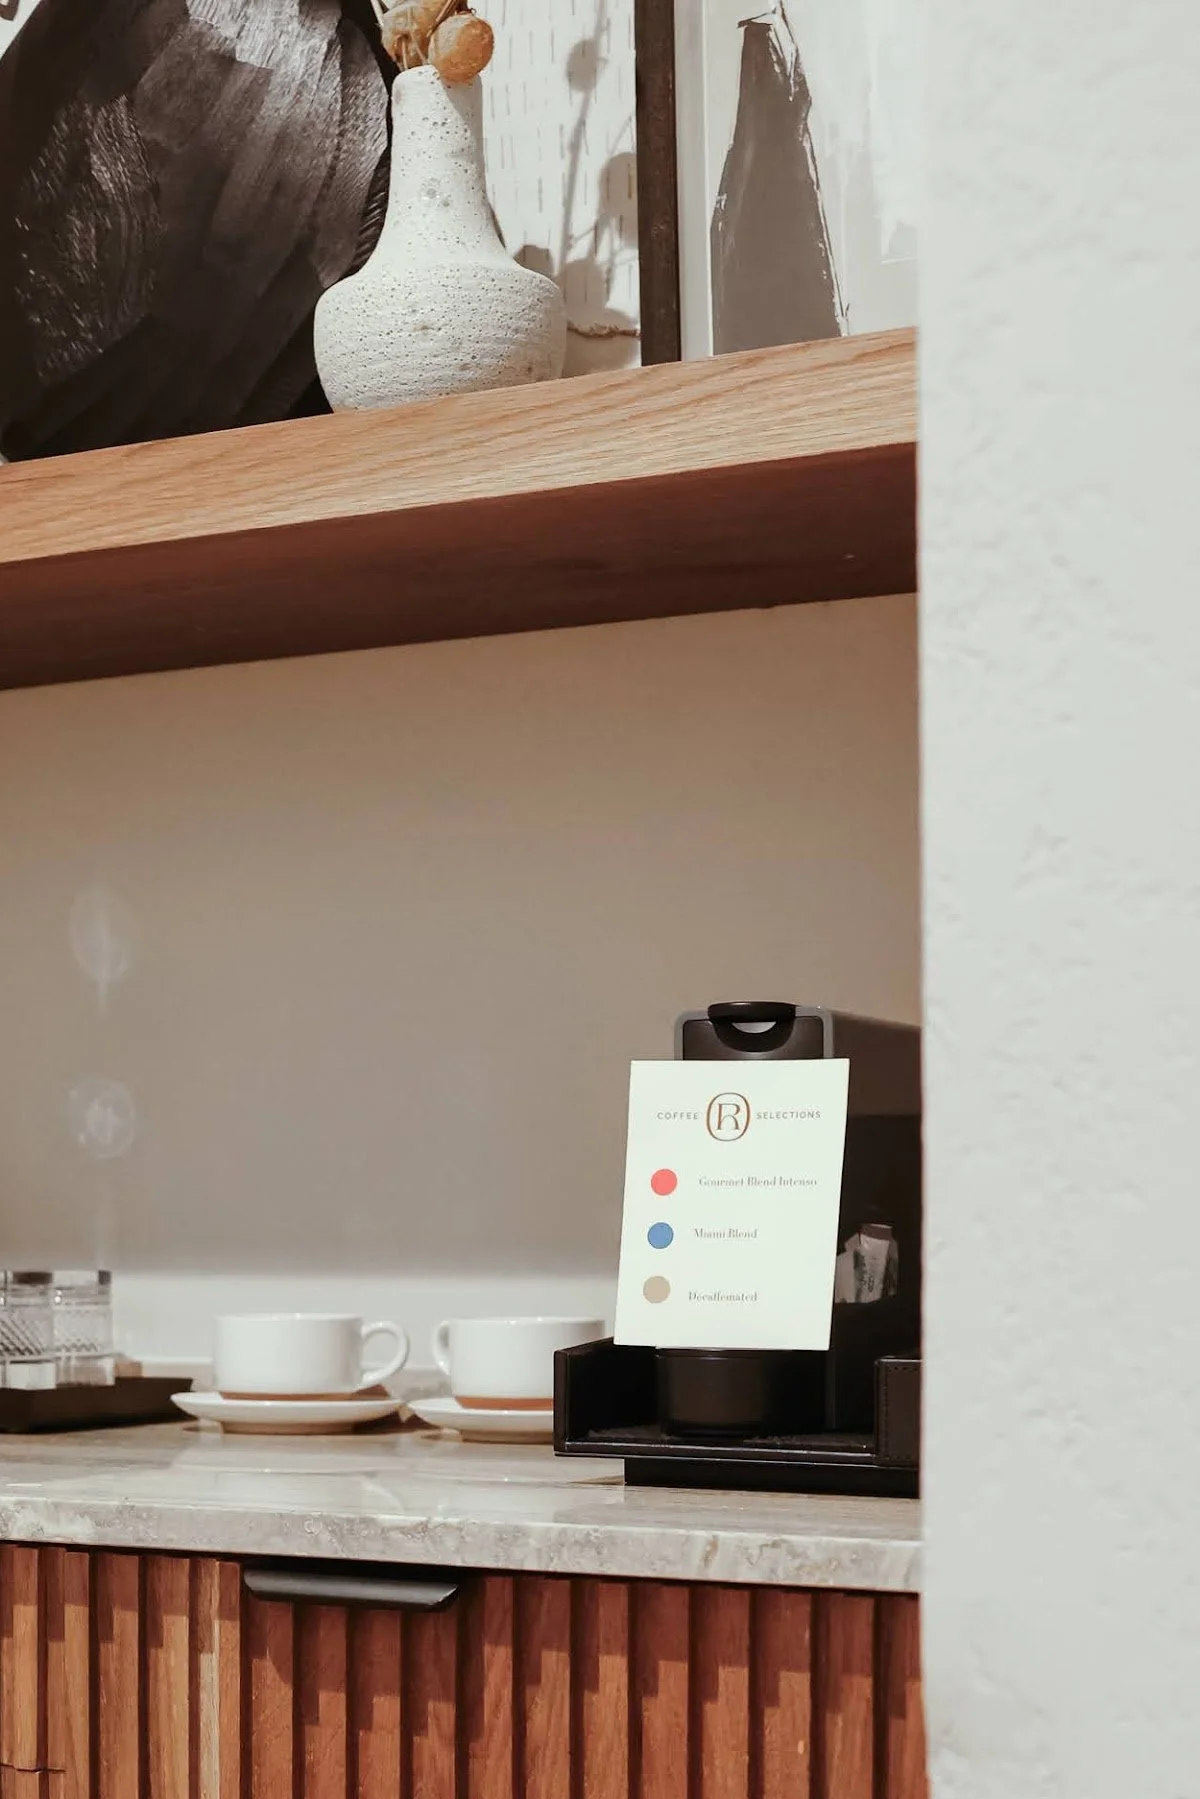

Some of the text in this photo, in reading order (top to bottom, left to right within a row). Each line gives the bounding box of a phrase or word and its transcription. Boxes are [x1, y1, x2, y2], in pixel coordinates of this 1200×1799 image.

[657, 1111, 699, 1121] COFFEE
[755, 1110, 822, 1121] SELECTIONS
[699, 1176, 818, 1187] Gourmet Blend Intenso
[694, 1228, 758, 1239] Miami Blend
